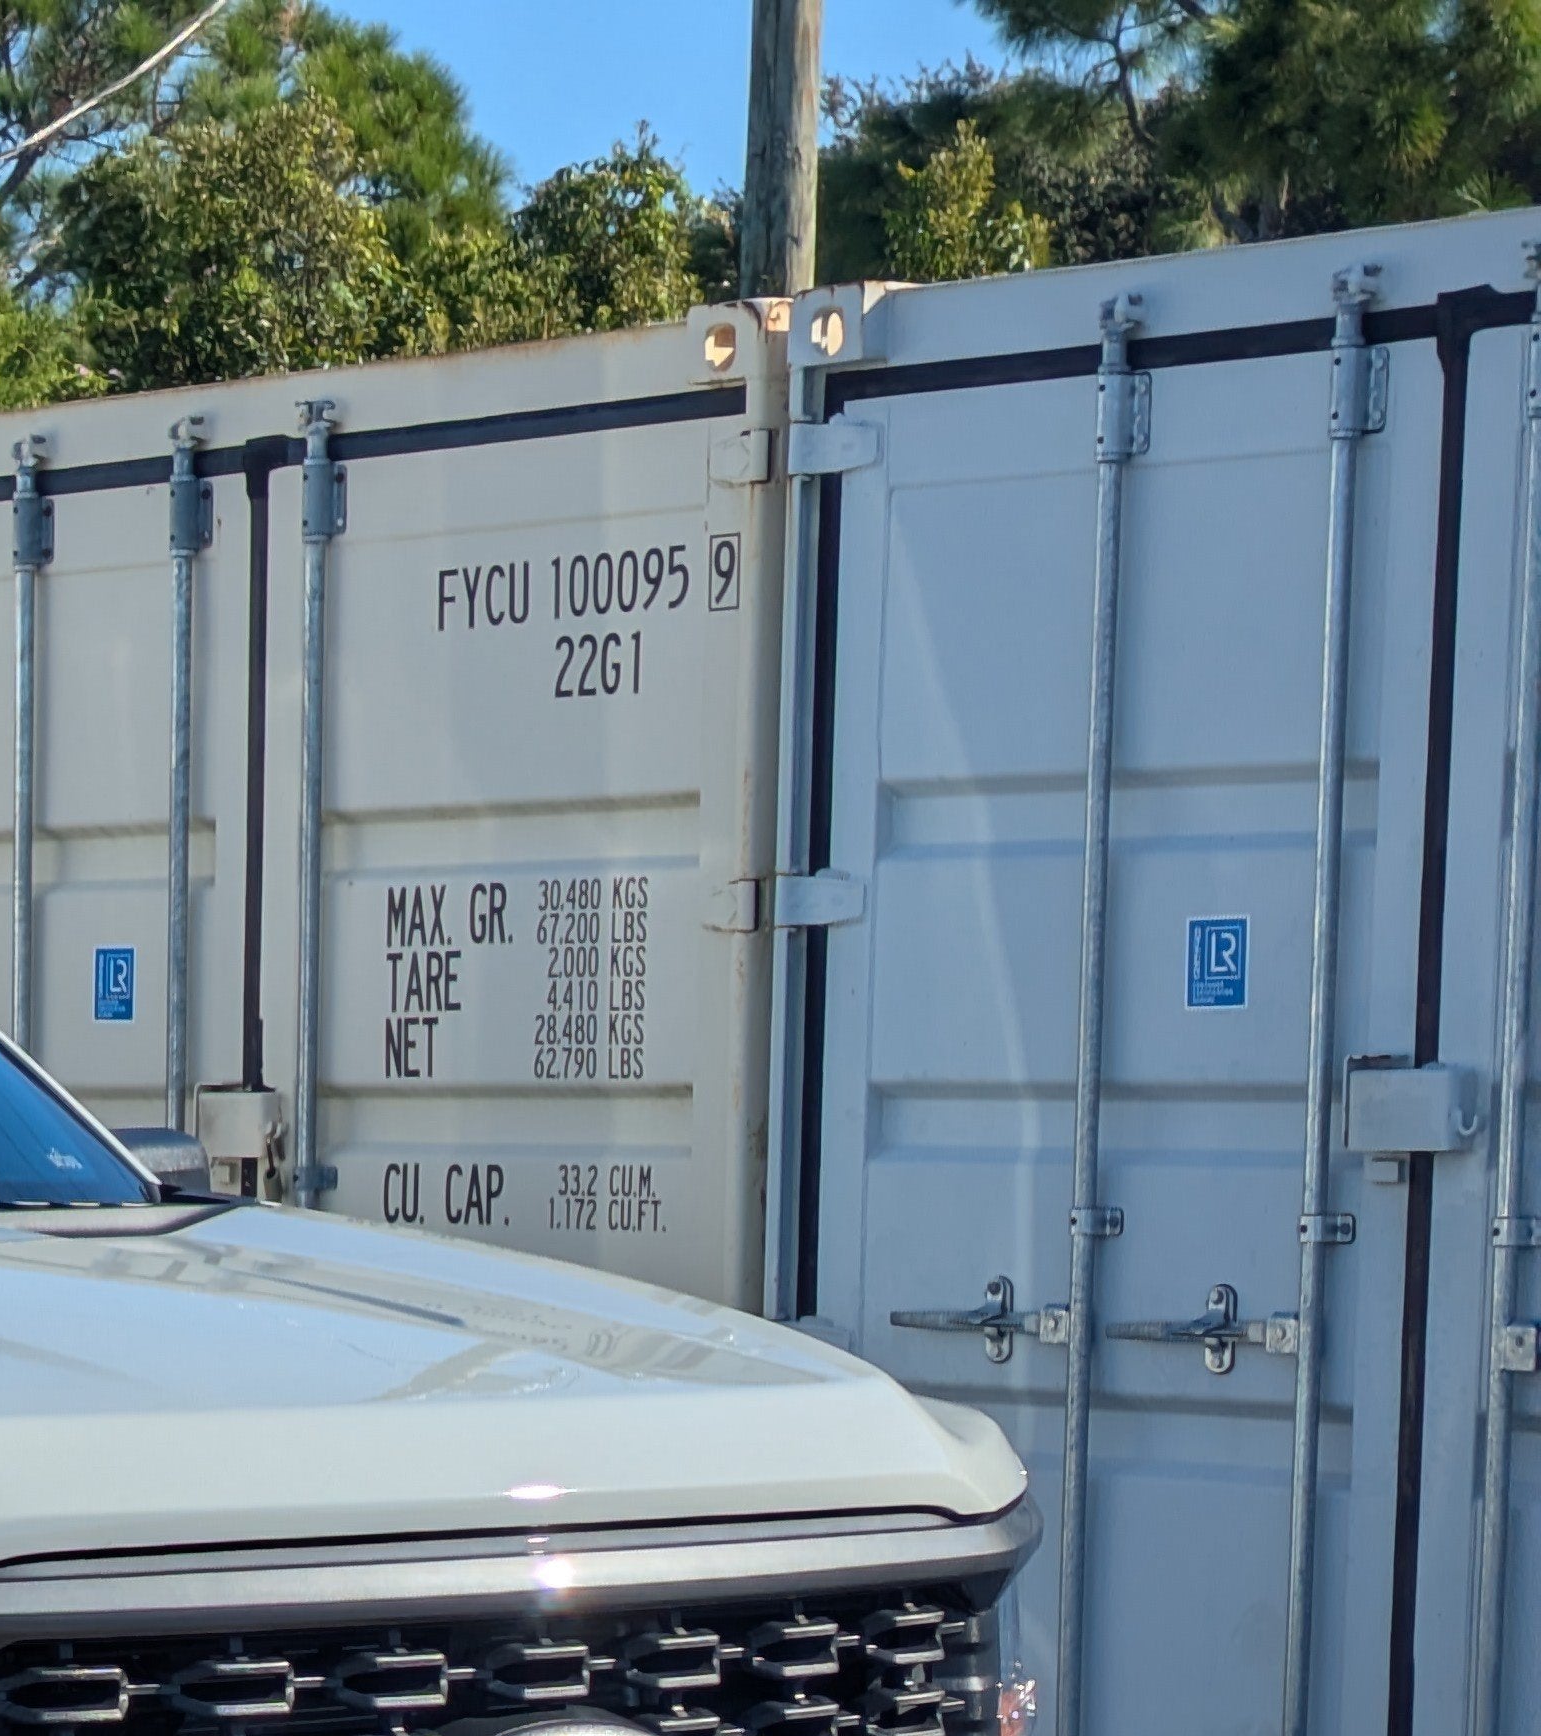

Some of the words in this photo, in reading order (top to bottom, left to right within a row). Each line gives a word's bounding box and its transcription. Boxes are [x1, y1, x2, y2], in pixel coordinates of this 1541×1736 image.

[437, 560, 530, 632] FYCU
[550, 544, 690, 620] 100095
[713, 540, 736, 605] 9
[554, 630, 642, 698] 22G1
[612, 876, 649, 909] KGS
[386, 884, 452, 948] MAX.
[469, 882, 514, 945] GR.
[611, 910, 648, 943] LBS
[610, 945, 646, 977] KGS
[1210, 932, 1237, 972] LR
[386, 950, 462, 1013] TARE
[609, 979, 646, 1011] LBS
[608, 1013, 645, 1045] KGS
[385, 1016, 439, 1079] NET
[608, 1047, 644, 1079] LBS
[383, 1162, 425, 1225] CU.
[445, 1163, 510, 1226] CAP.
[558, 1164, 598, 1197] 33.2
